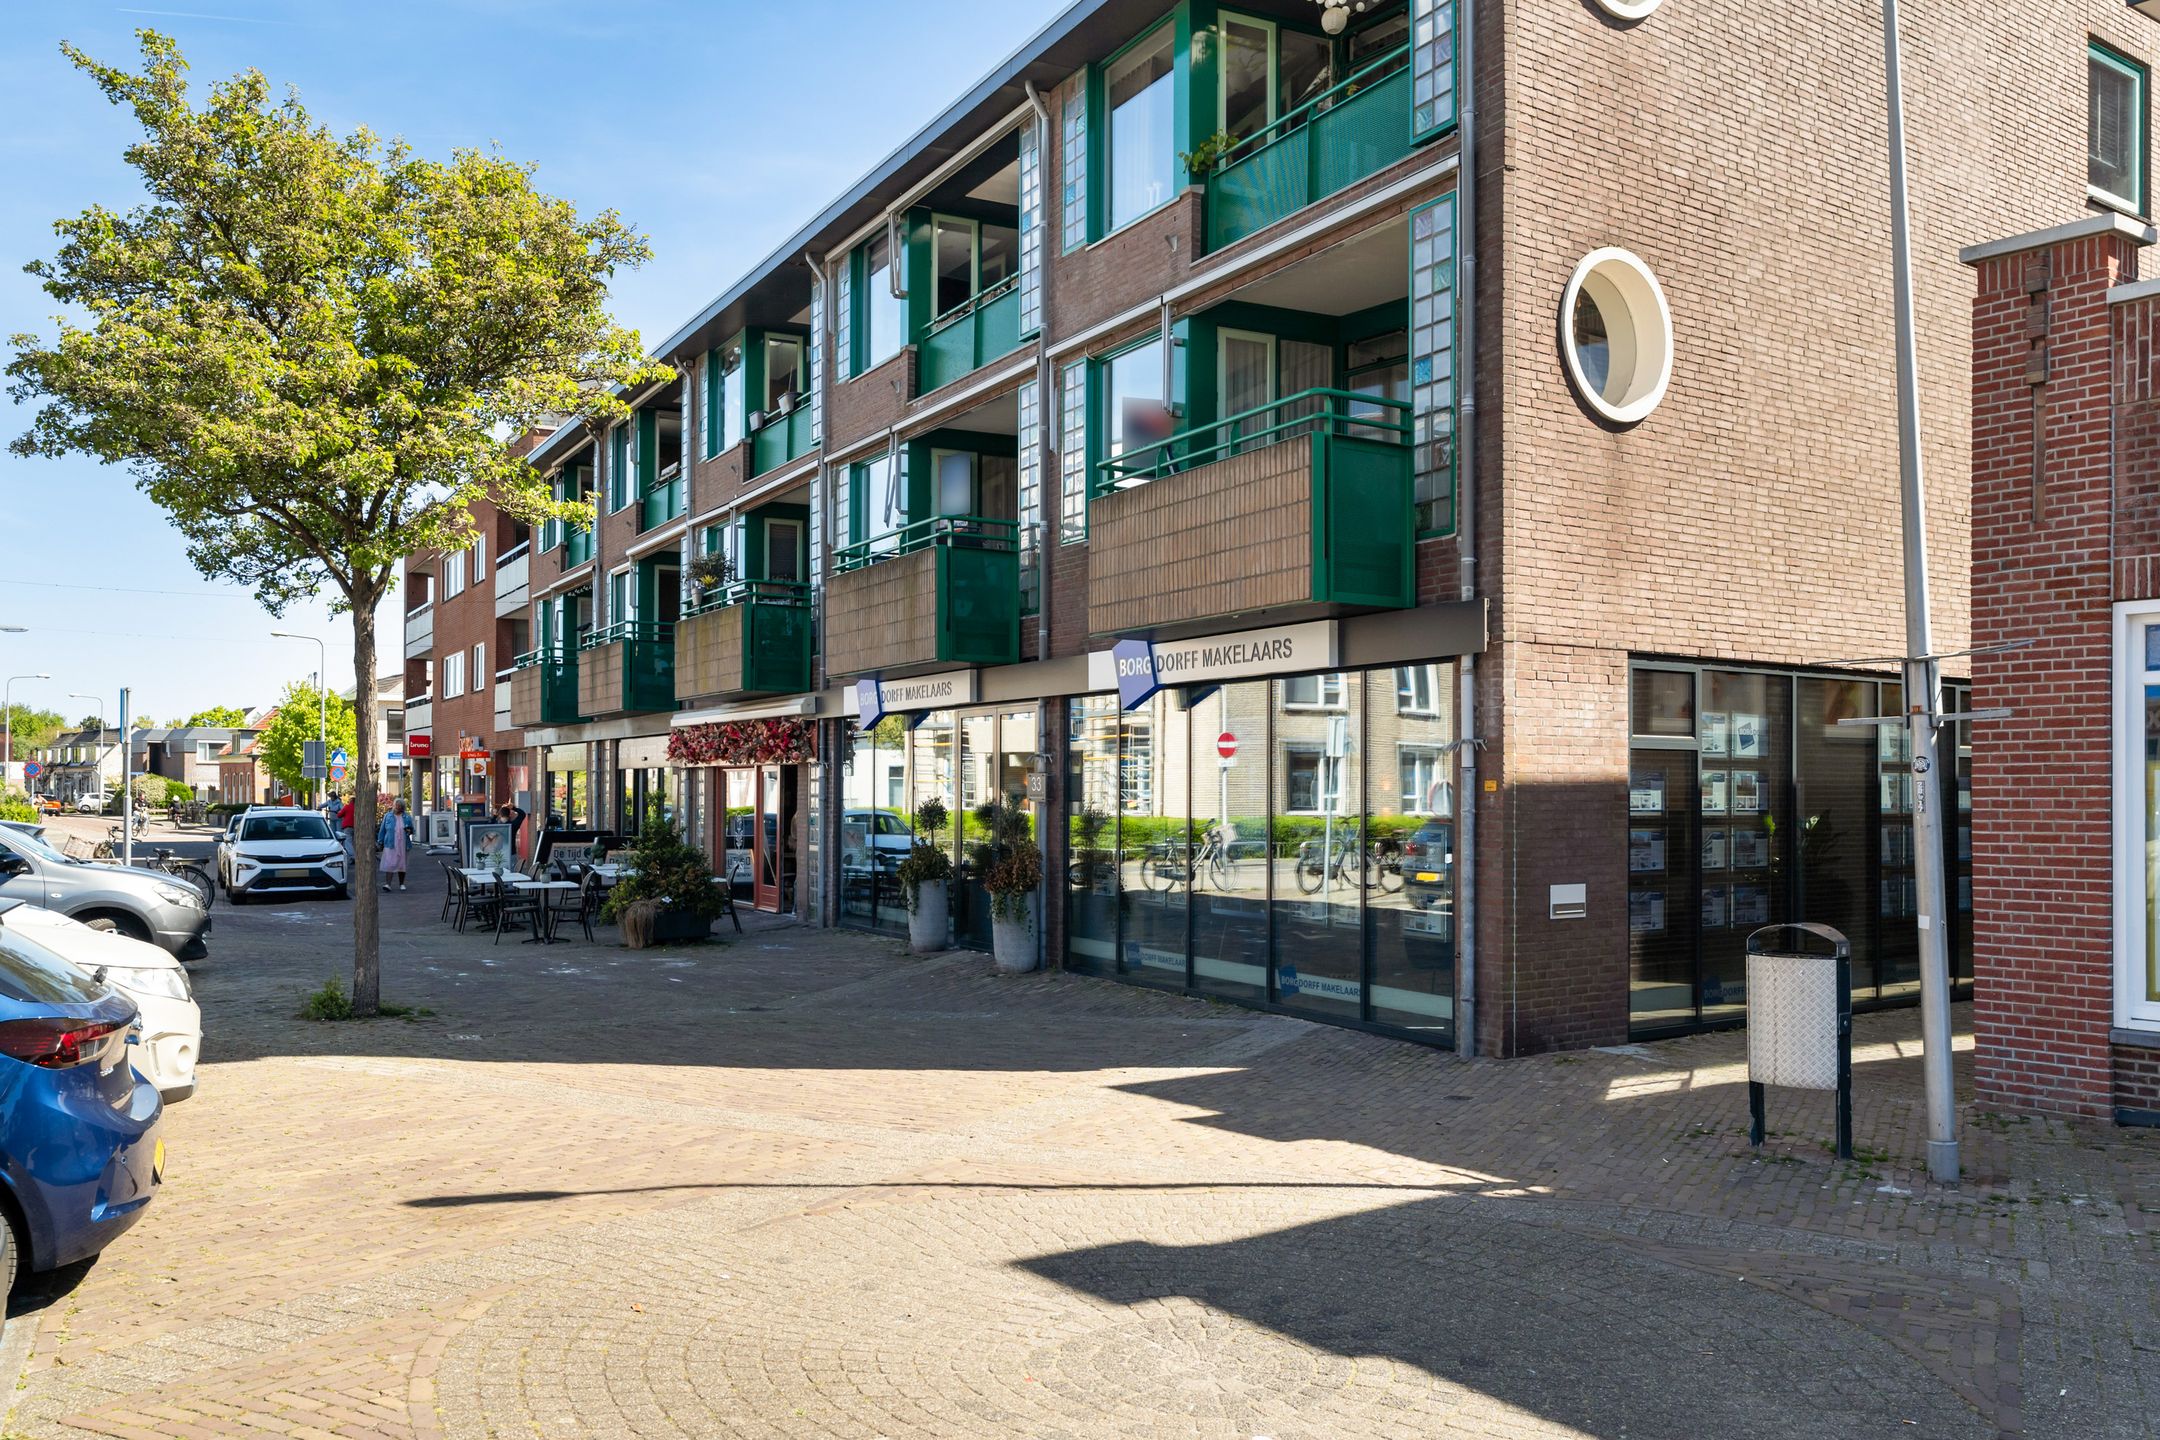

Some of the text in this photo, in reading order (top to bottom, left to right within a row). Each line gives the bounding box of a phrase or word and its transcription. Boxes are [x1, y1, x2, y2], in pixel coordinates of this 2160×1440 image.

[1202, 638, 1293, 668] MAKELAARS
[905, 681, 953, 701] MAKELAARS
[1031, 776, 1042, 791] 33
[553, 848, 582, 861] De Tijd
